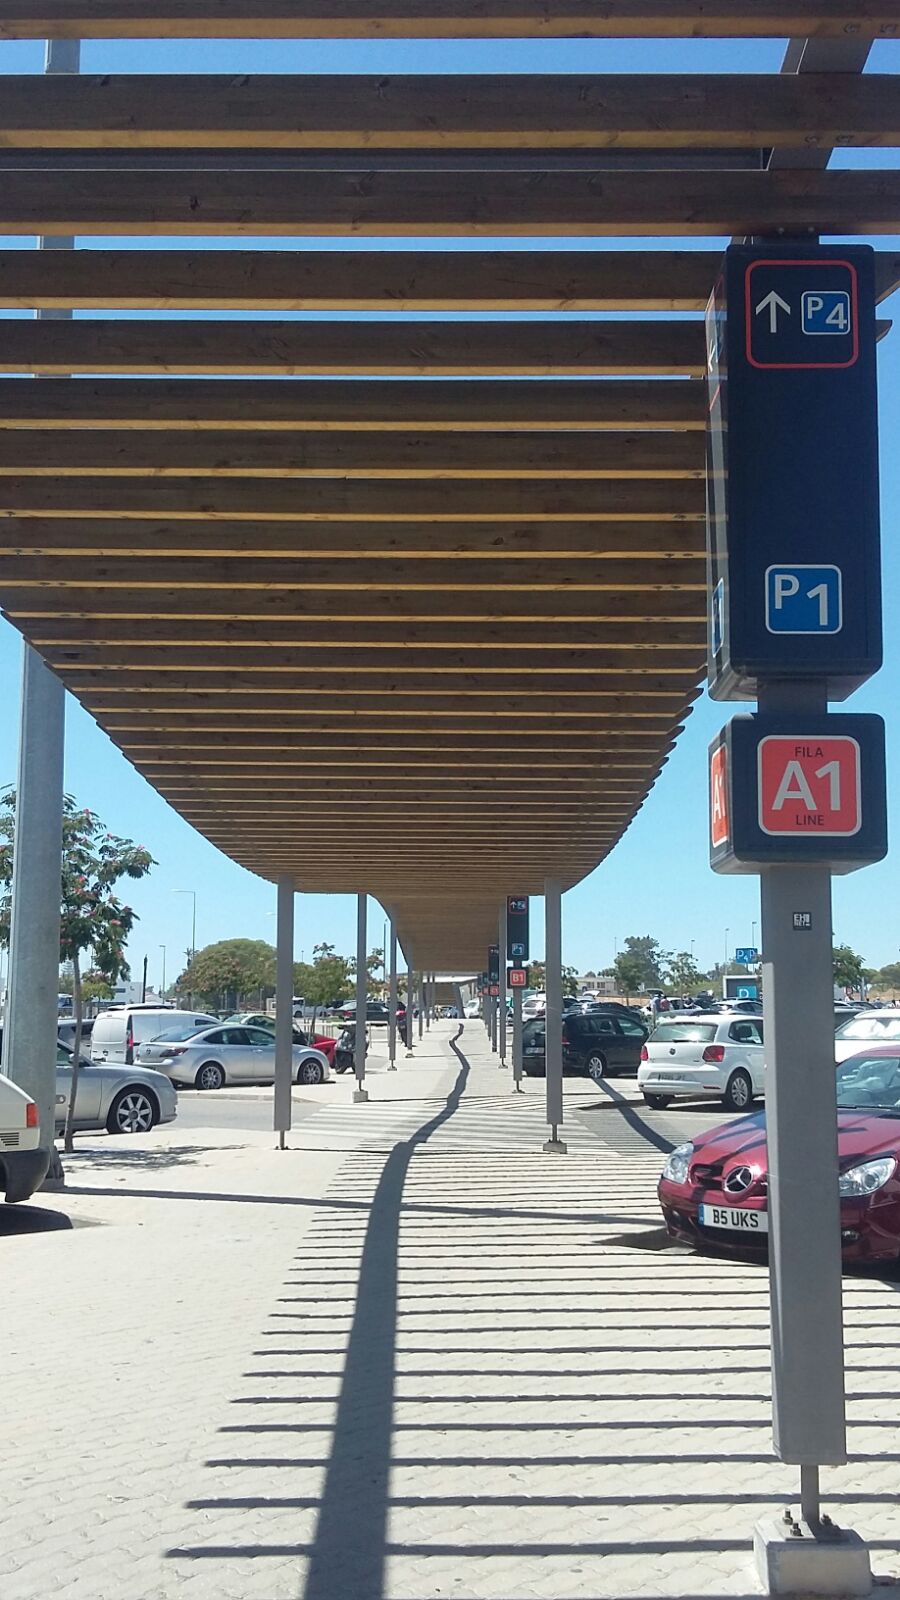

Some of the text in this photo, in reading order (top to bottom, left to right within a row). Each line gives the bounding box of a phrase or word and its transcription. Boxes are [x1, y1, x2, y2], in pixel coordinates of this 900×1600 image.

[807, 296, 847, 330] P4
[774, 574, 828, 626] P1
[794, 746, 824, 758] FILA
[771, 760, 841, 811] A1
[796, 814, 825, 826] LINE
[512, 974, 524, 982] B1
[713, 1208, 759, 1228] B5 UKS
